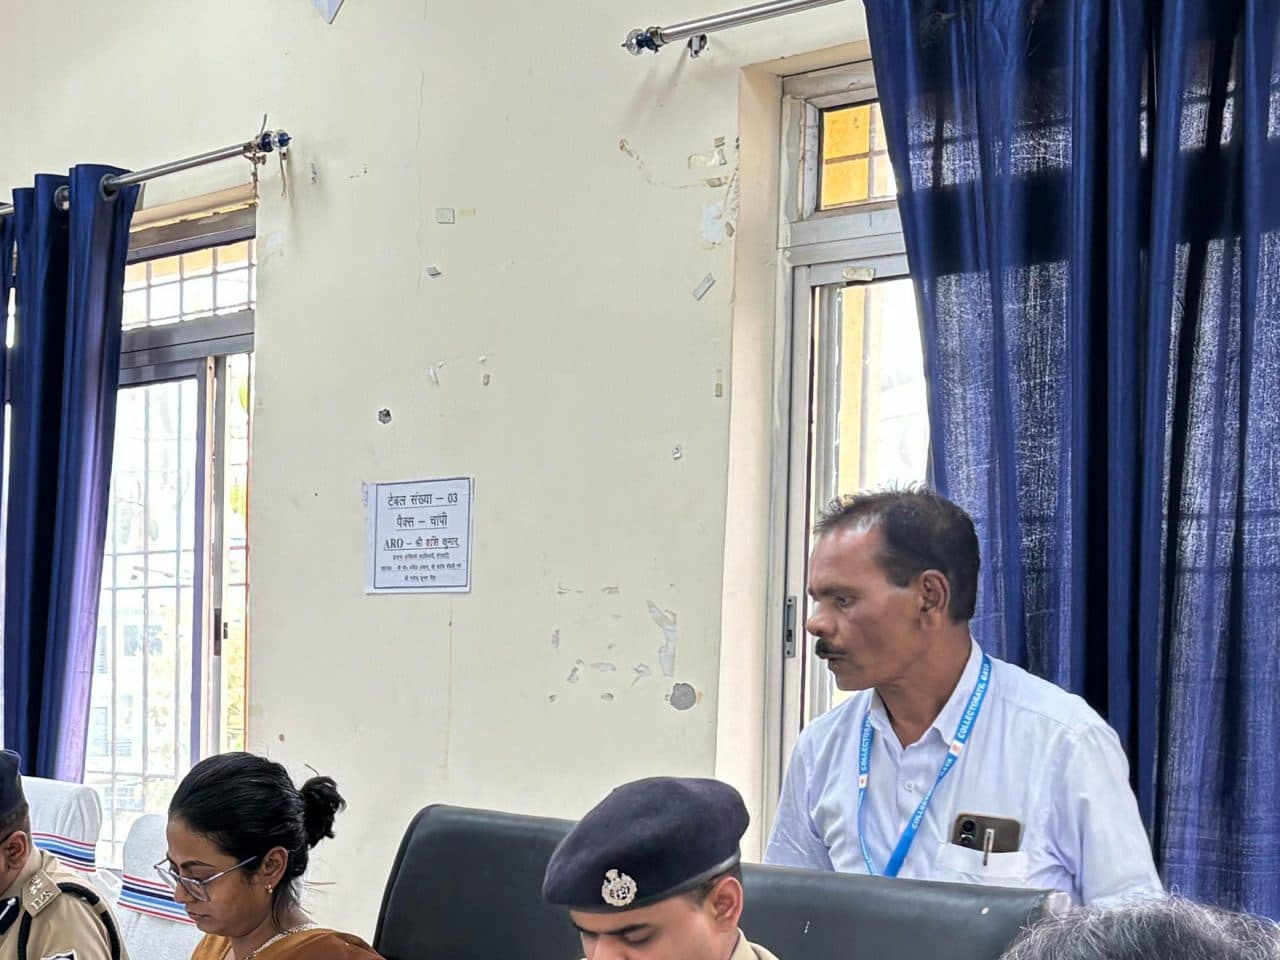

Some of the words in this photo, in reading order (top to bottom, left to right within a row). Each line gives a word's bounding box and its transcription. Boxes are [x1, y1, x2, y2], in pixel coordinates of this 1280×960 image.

[387, 492, 406, 507] टेबल
[410, 491, 432, 505] संख्या
[448, 492, 458, 503] 03
[384, 538, 404, 549] ARO
